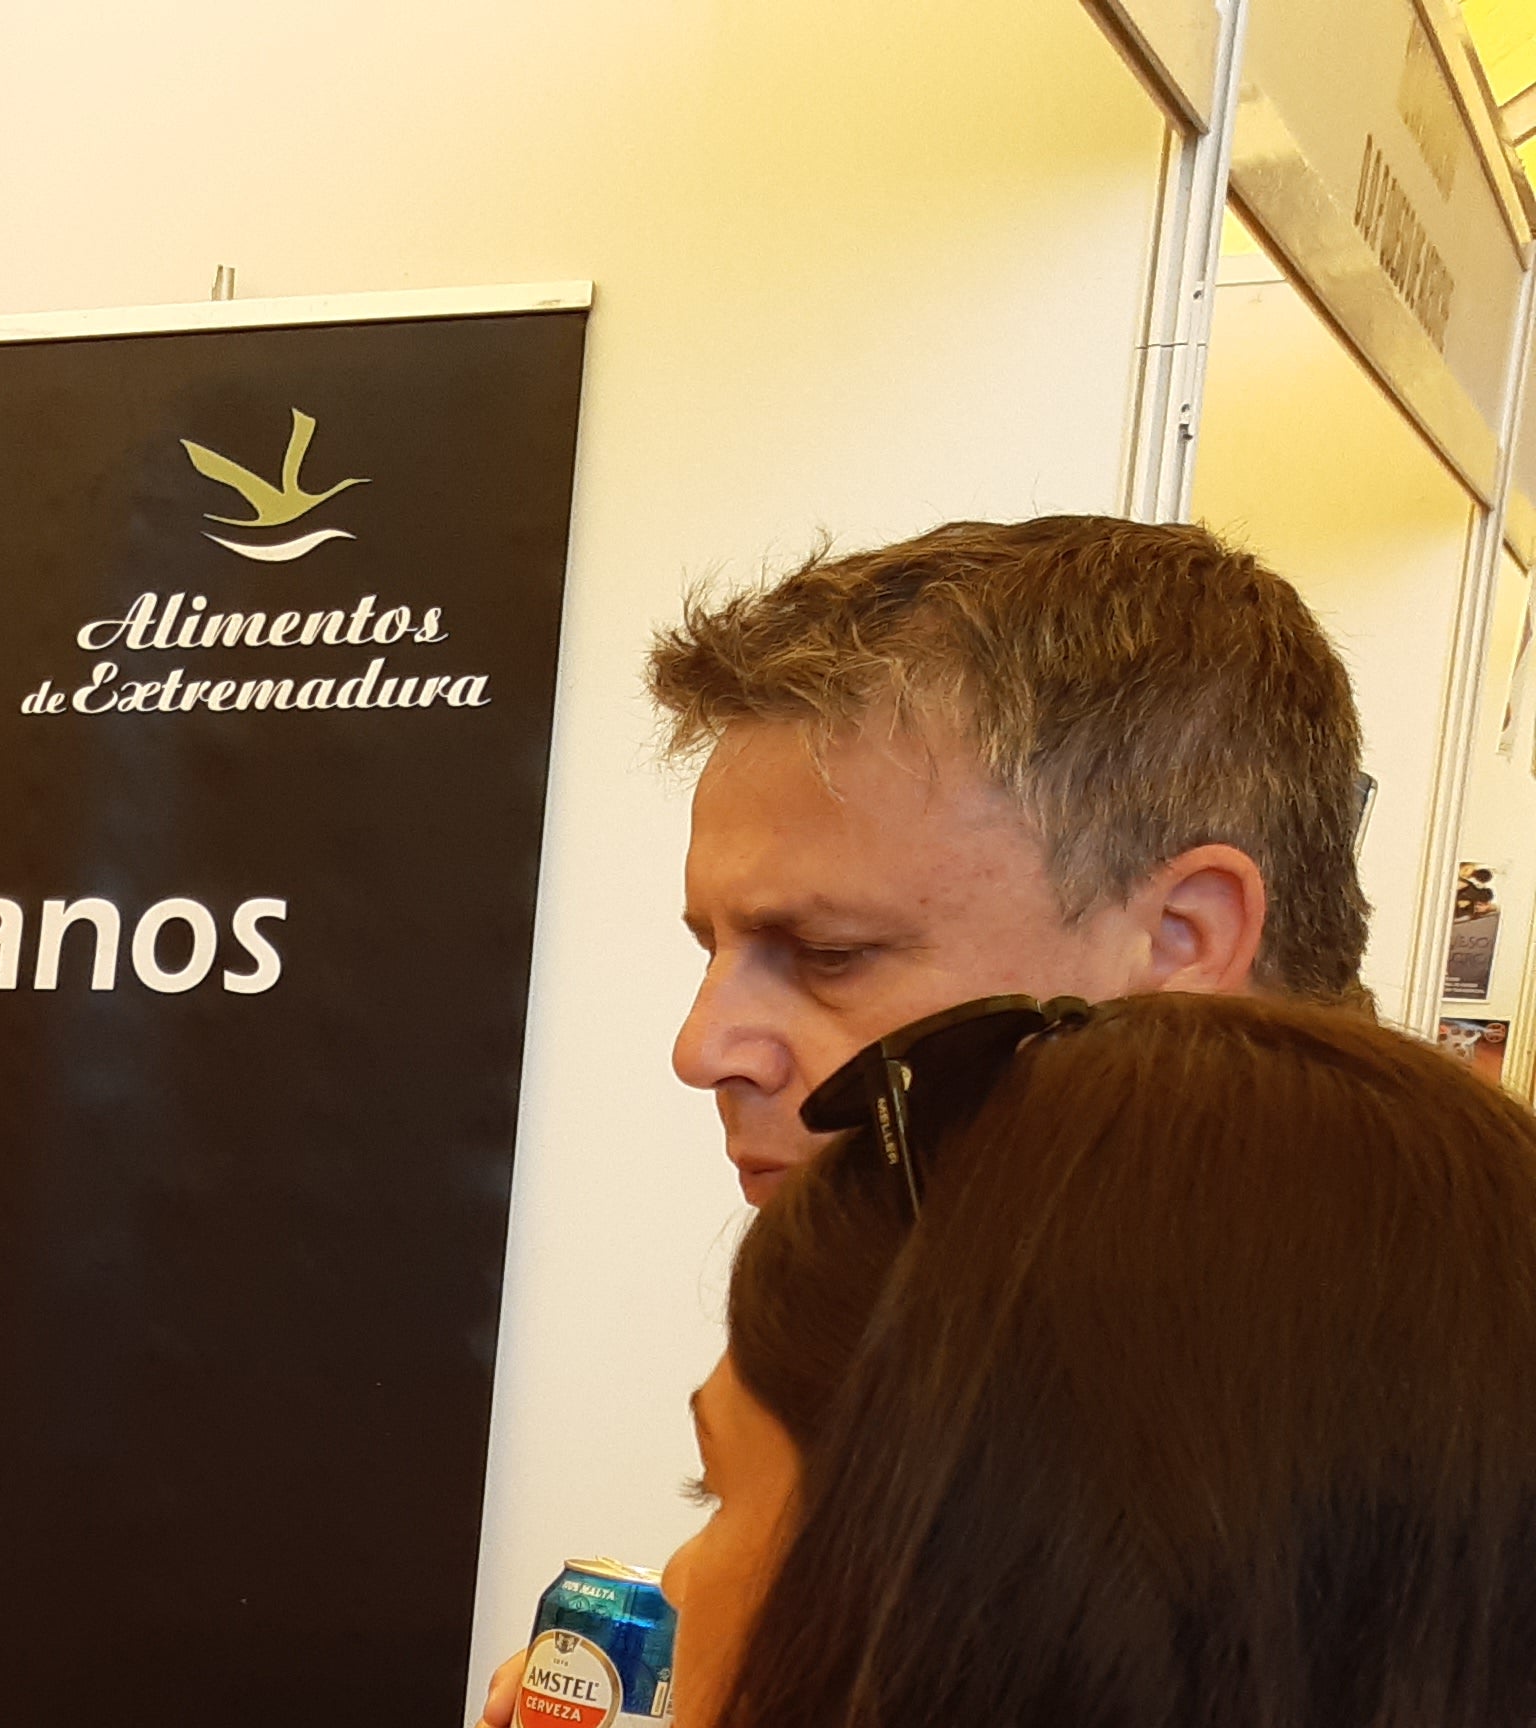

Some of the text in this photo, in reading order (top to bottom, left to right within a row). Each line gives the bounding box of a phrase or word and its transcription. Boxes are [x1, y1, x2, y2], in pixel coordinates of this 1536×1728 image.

[77, 592, 451, 652] Alimentos
[20, 657, 493, 716] de Extremadura
[581, 1582, 616, 1600] MALTA
[527, 1666, 597, 1701] AMSTEL
[525, 1695, 582, 1723] CERVEZA
